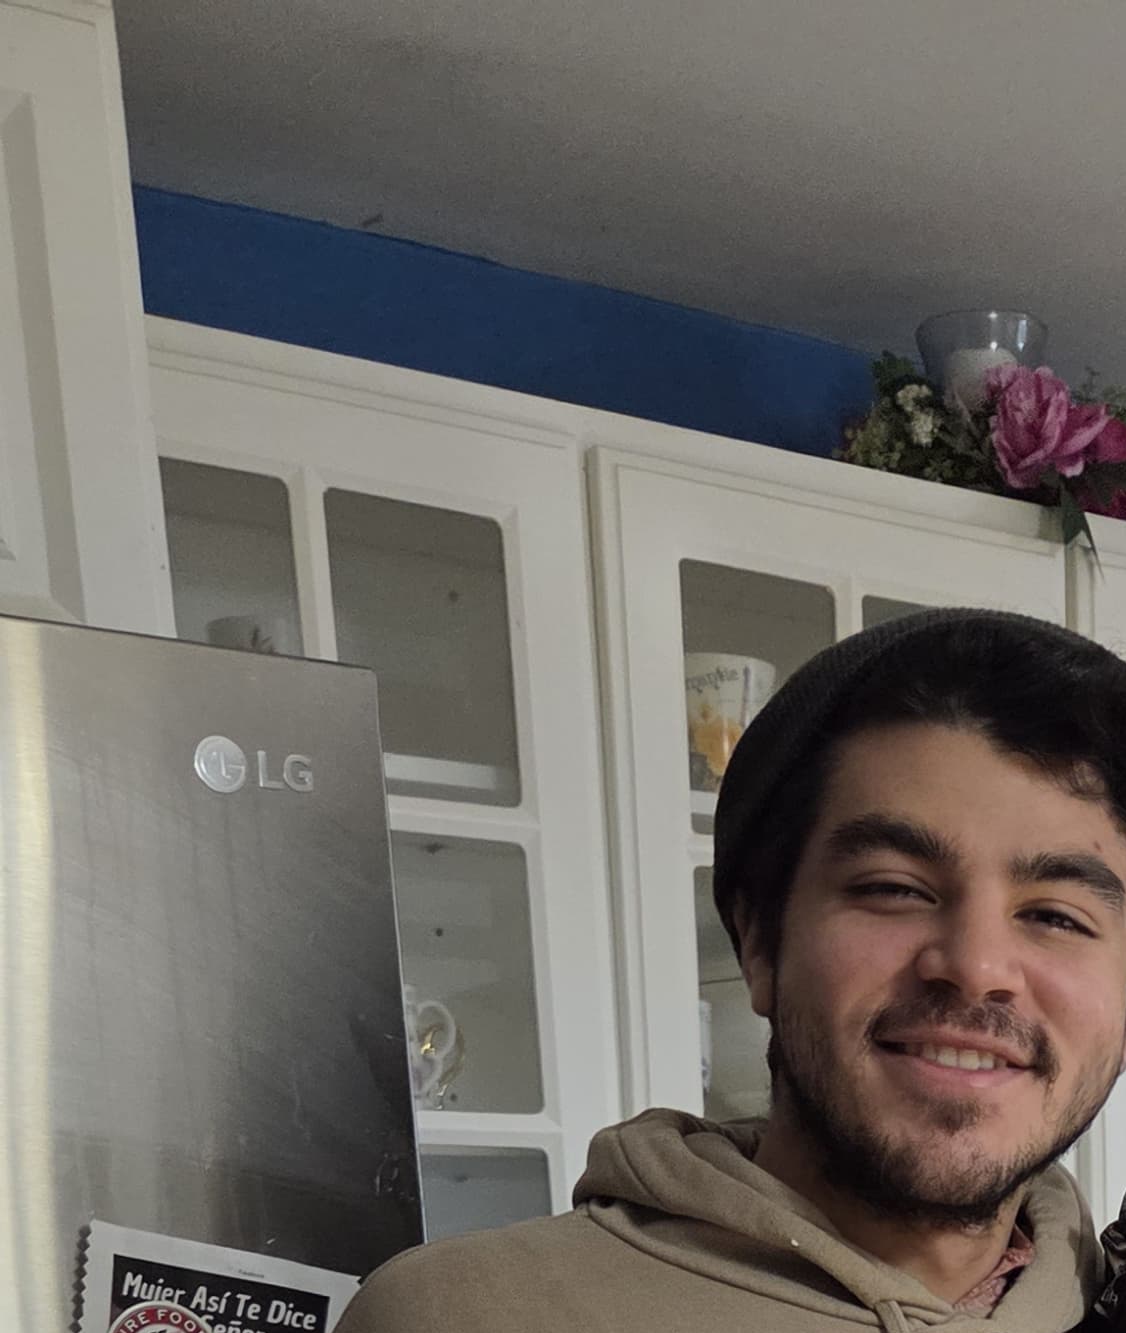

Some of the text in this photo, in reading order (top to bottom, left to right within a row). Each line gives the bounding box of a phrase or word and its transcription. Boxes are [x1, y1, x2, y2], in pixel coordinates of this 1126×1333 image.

[257, 750, 314, 792] LG
[122, 1271, 316, 1330] Mujer Así Te Dice
